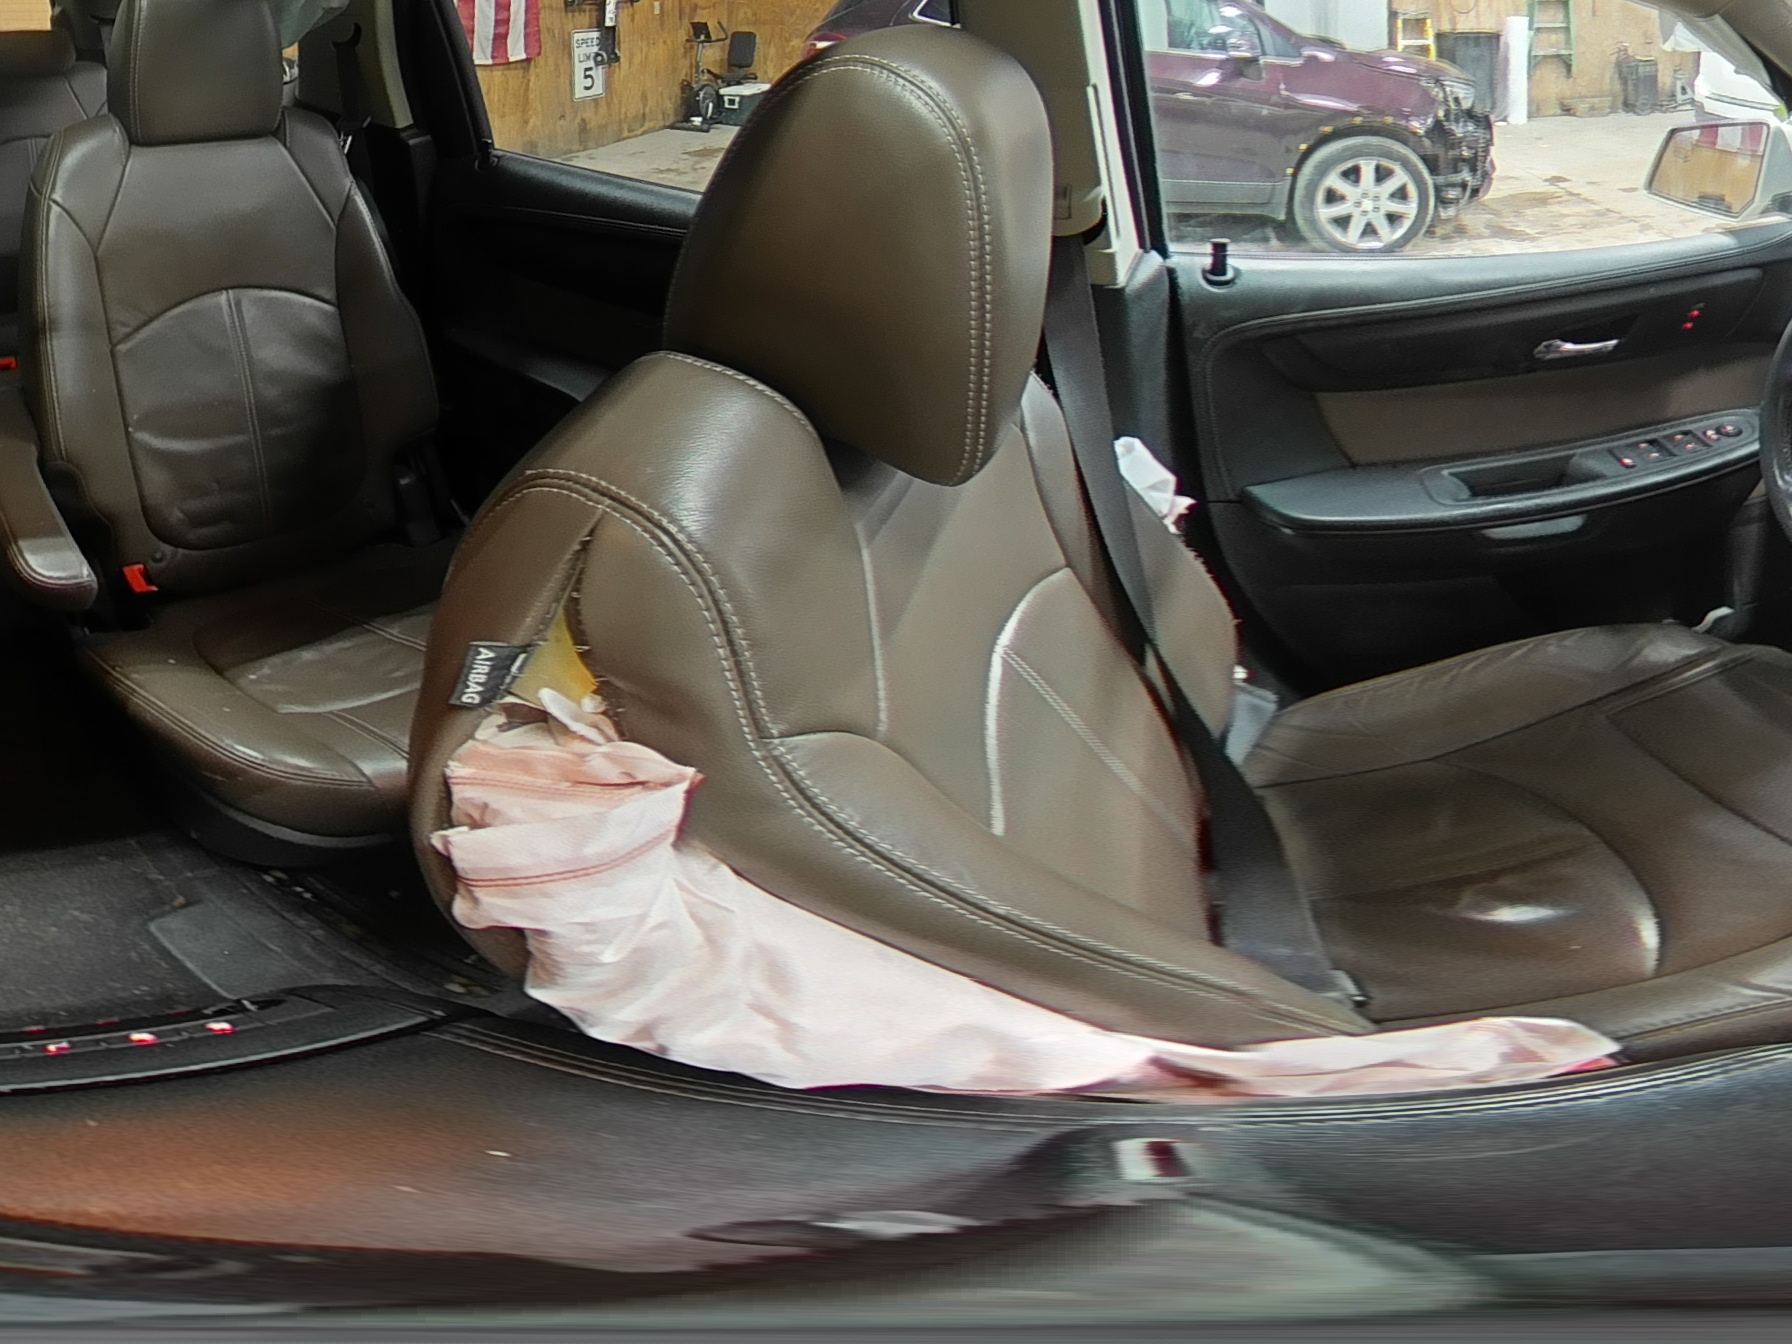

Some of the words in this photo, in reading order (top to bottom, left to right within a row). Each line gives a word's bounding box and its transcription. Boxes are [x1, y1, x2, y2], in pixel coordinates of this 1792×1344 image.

[575, 36, 601, 48] SPEED
[583, 66, 595, 91] 5
[460, 647, 497, 705] AIRBAG
